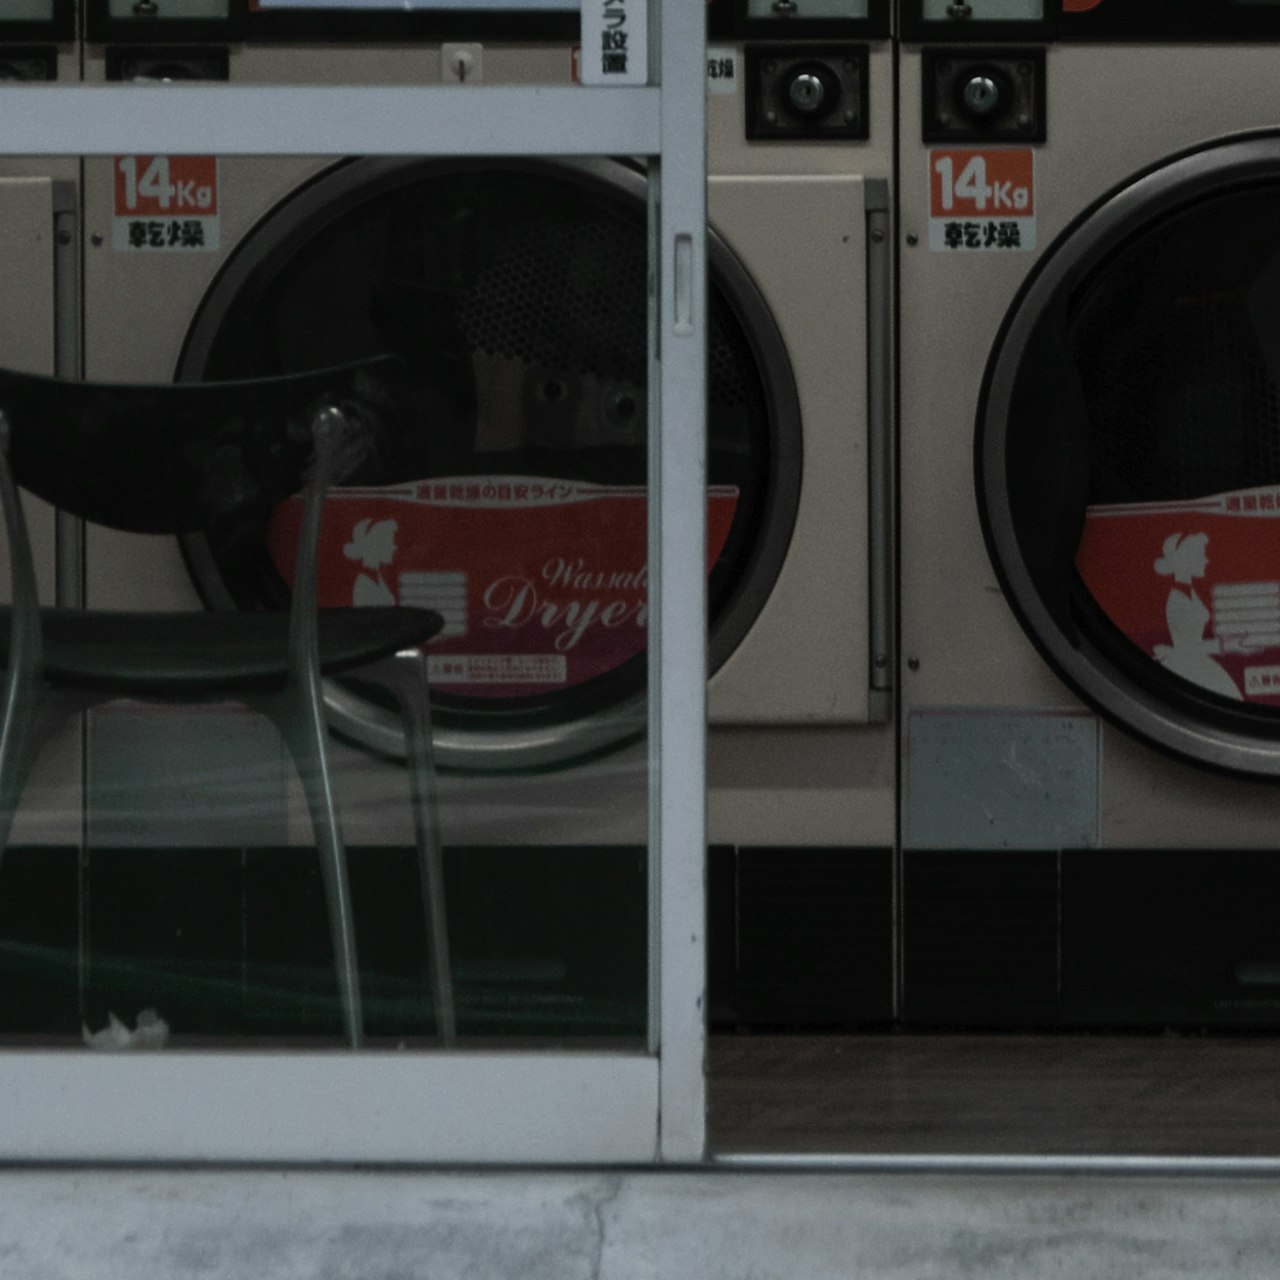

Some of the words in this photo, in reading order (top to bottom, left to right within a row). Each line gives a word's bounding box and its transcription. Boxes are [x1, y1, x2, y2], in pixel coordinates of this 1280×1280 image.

[119, 156, 211, 209] 14Kg
[935, 155, 1028, 210] 14Kg
[128, 221, 204, 247] 乾燥
[944, 222, 1020, 248] 乾燥
[542, 558, 648, 590] Wassal
